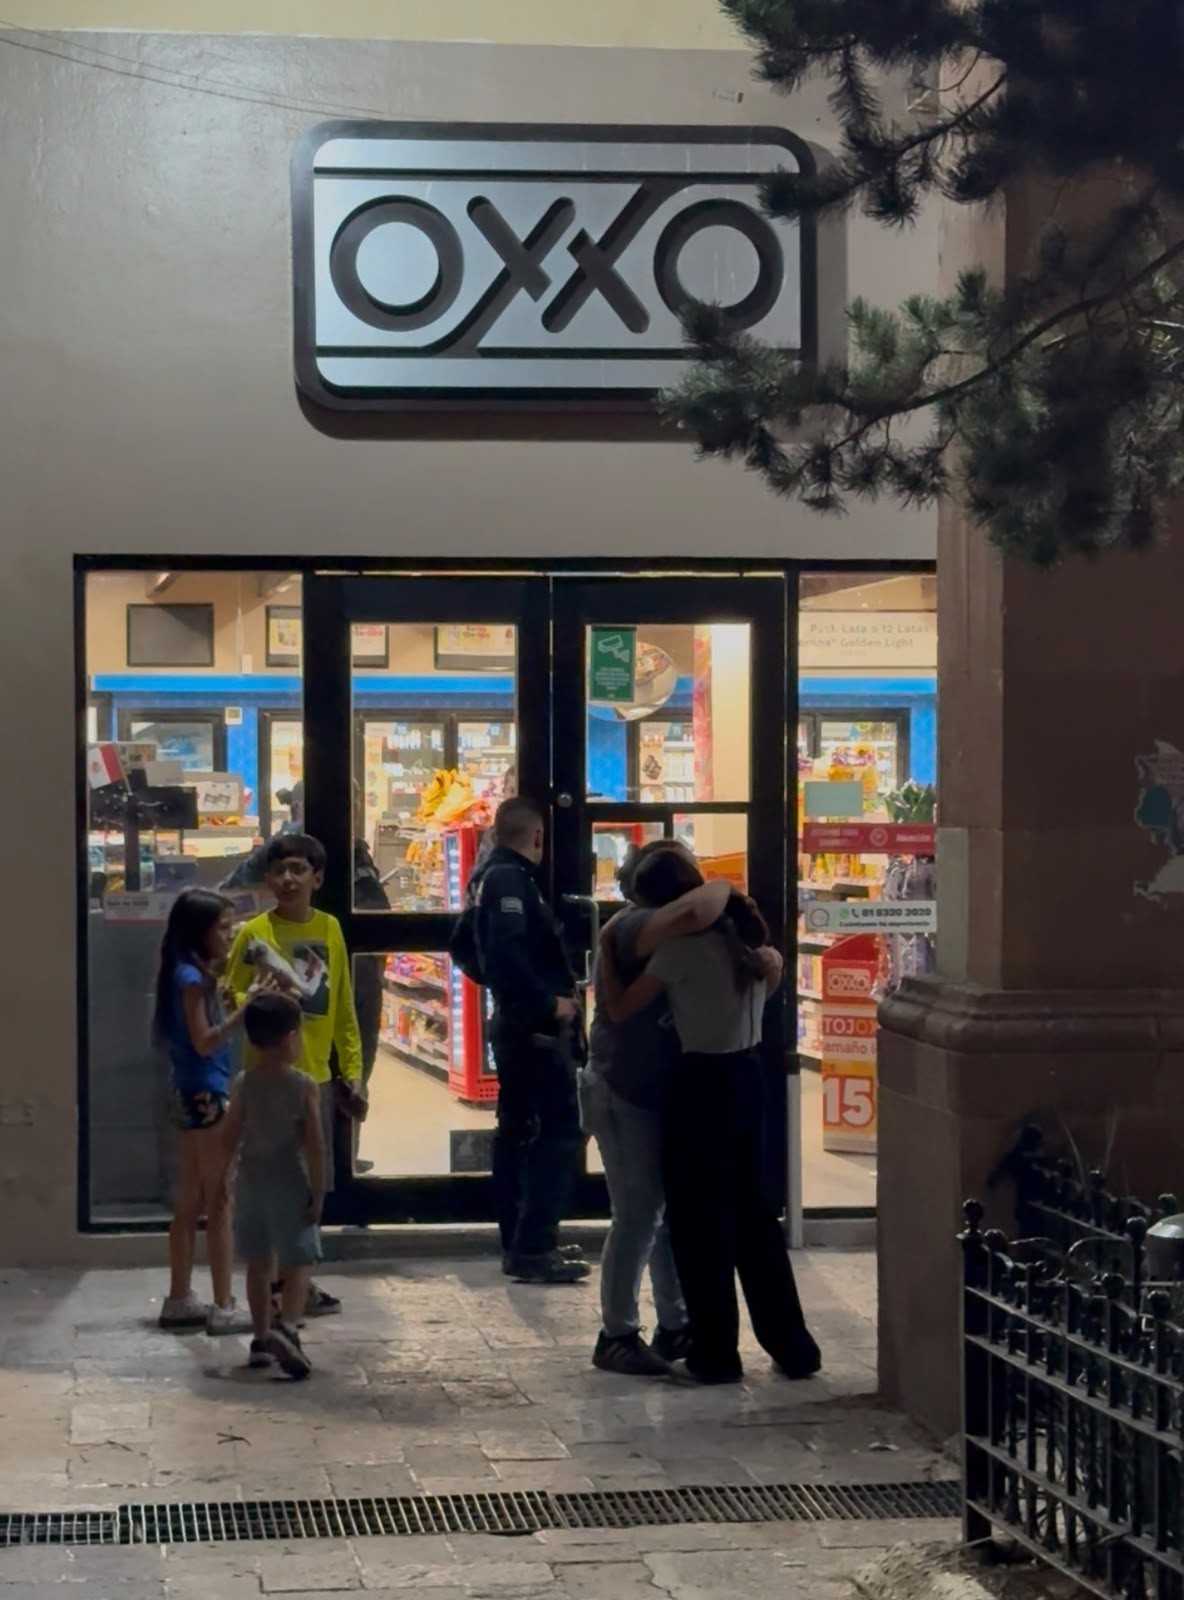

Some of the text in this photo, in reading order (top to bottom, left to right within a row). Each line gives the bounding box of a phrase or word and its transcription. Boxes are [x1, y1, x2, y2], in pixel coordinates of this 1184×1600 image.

[329, 182, 785, 354] OXXO
[830, 974, 868, 991] OXXO
[824, 1040, 868, 1055] amaño
[823, 1076, 874, 1127] 15
